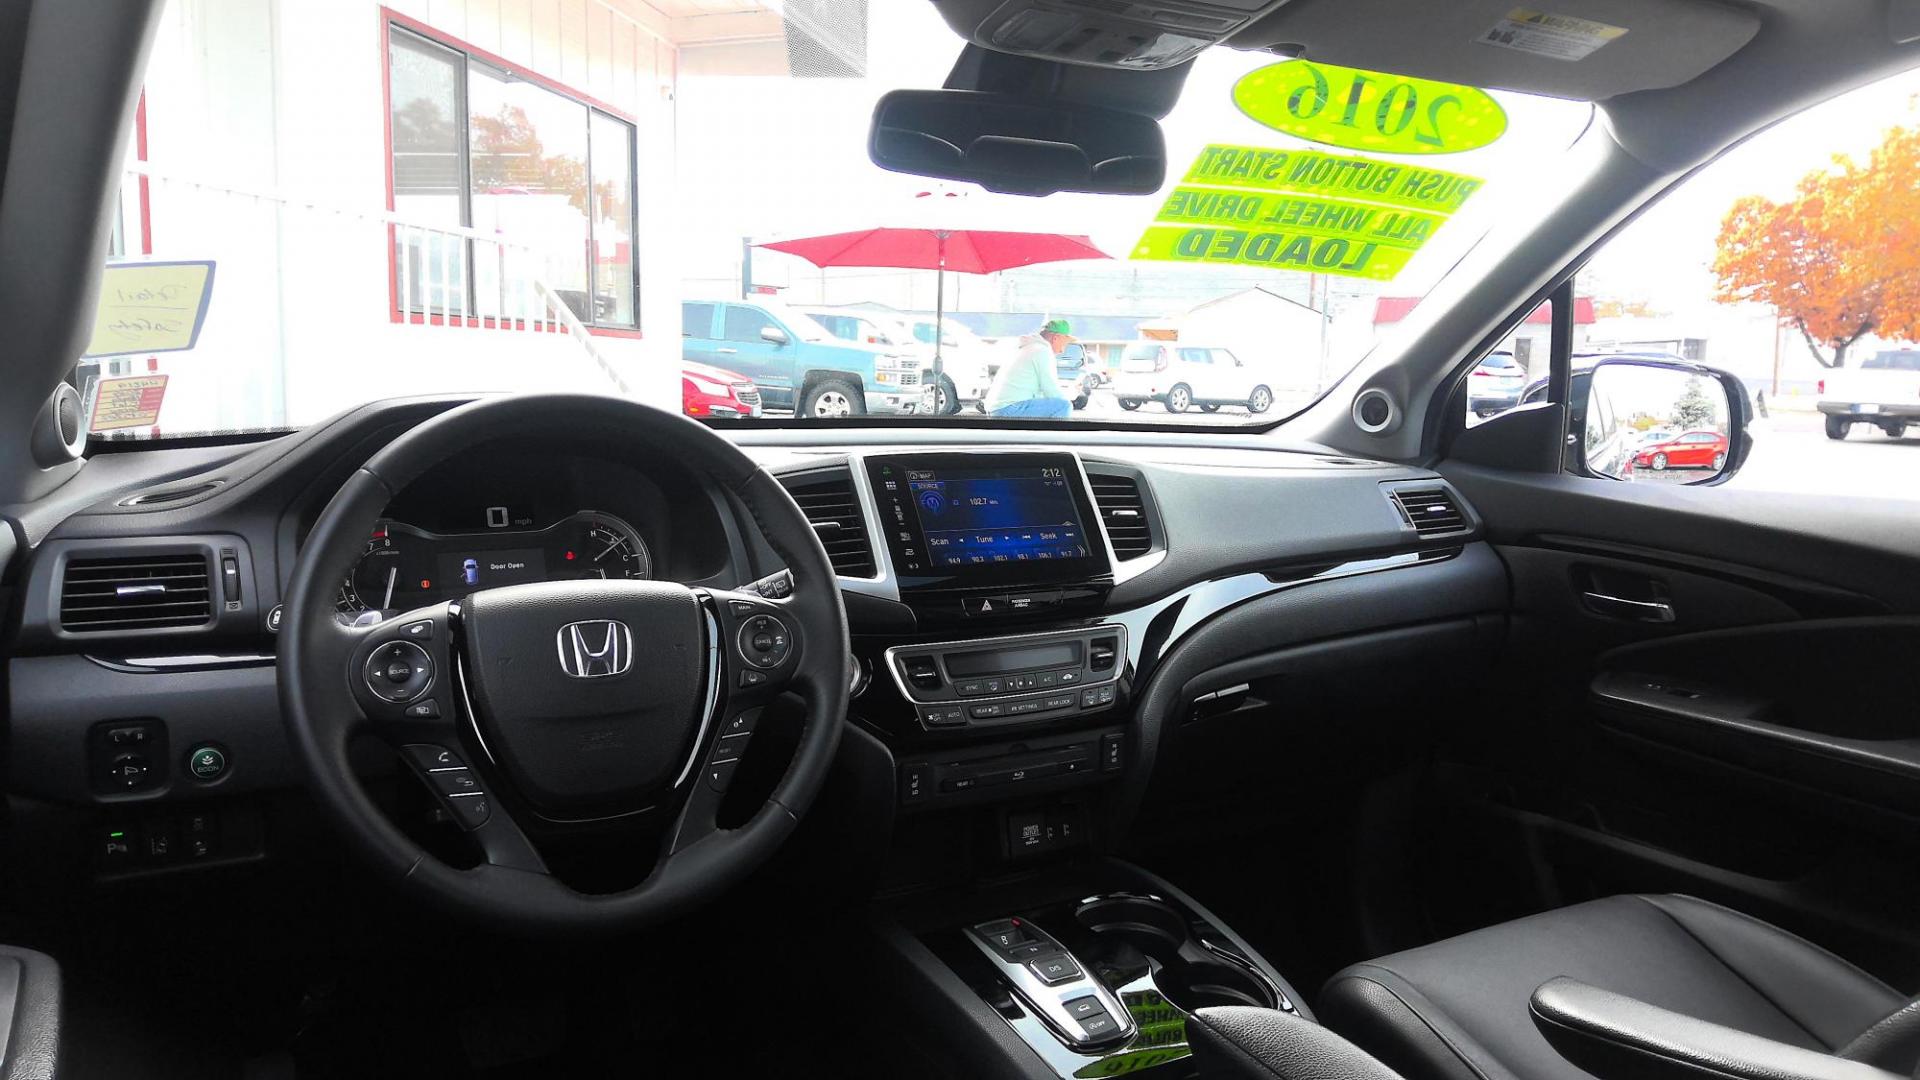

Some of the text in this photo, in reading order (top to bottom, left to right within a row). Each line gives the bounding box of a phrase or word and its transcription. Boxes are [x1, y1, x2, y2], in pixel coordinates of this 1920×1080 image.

[1041, 467, 1062, 478] 2:12
[930, 532, 1058, 546] Scan Tune Seek
[490, 562, 506, 570] Door
